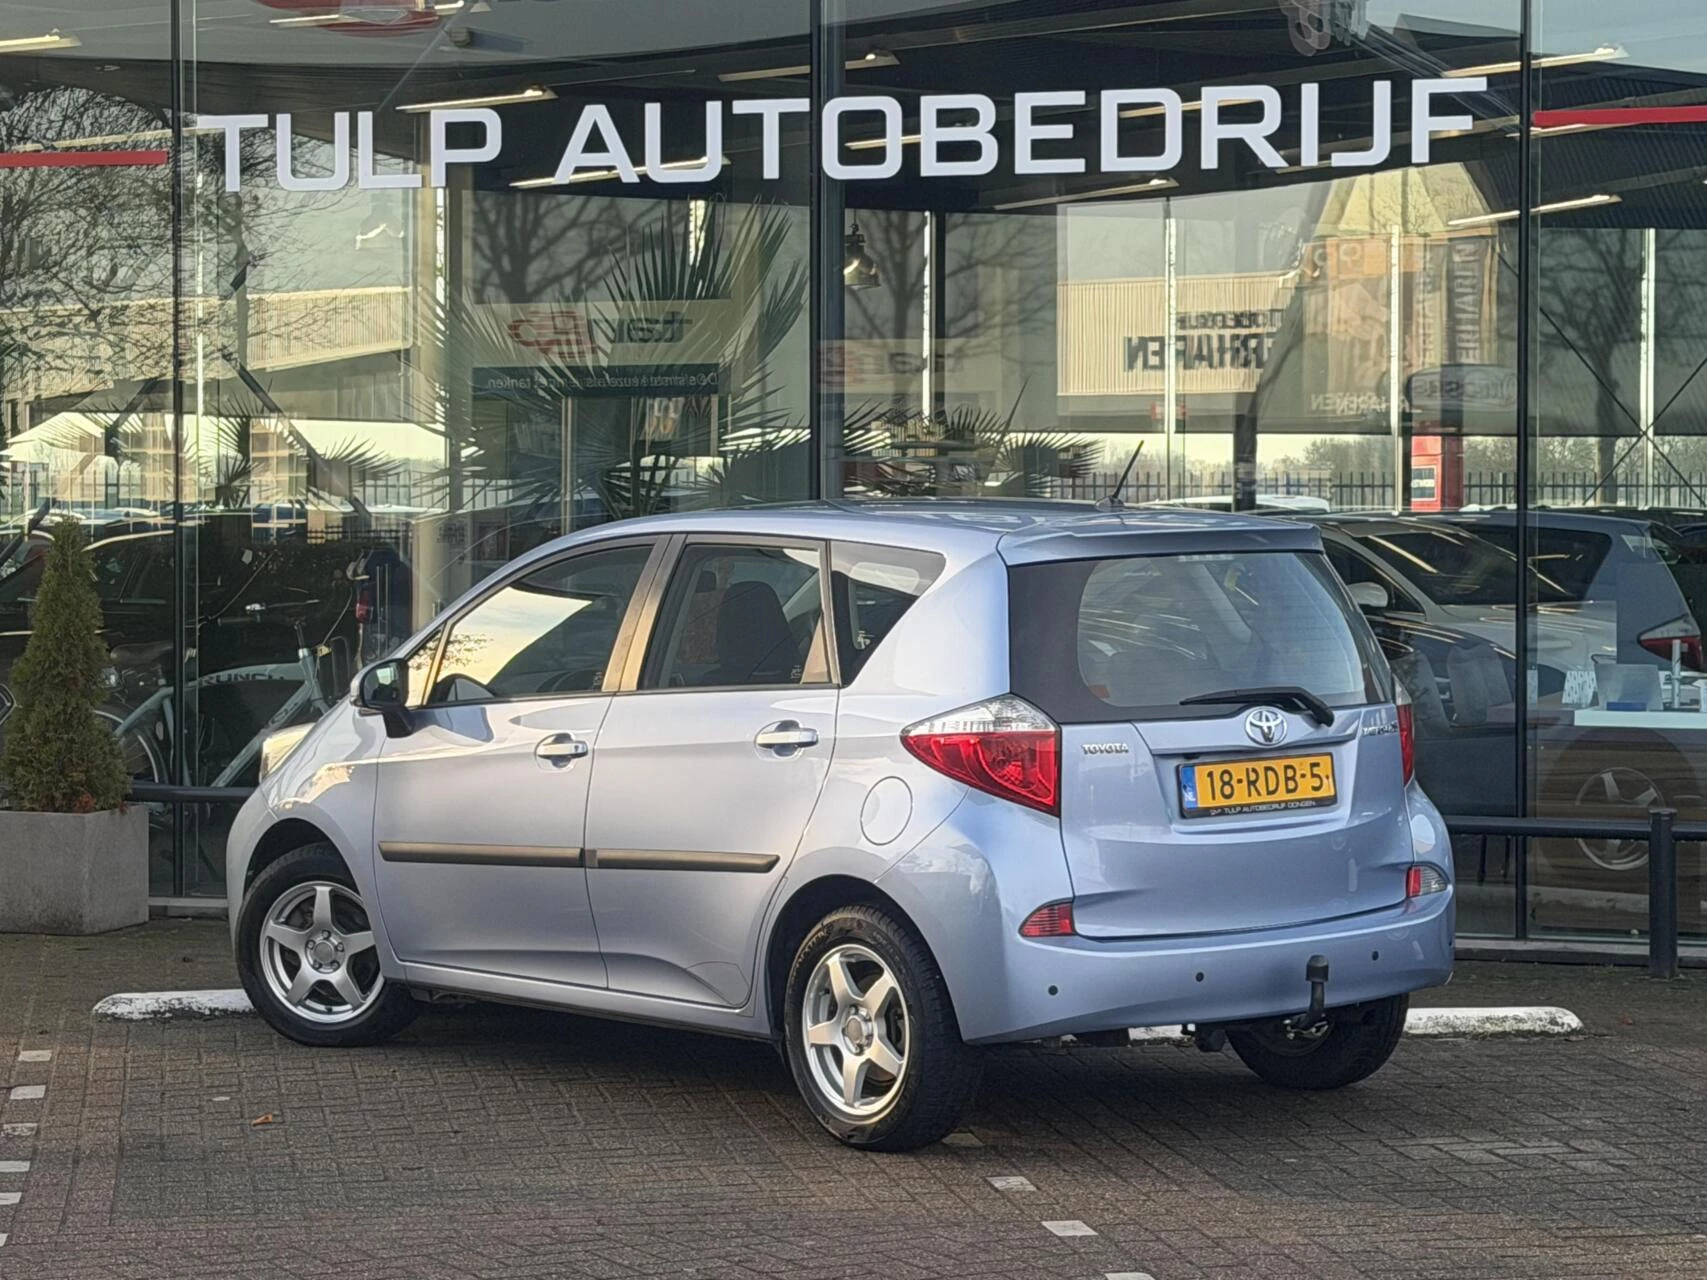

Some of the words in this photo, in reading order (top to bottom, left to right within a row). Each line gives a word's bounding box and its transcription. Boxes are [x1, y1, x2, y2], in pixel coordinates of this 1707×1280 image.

[195, 108, 502, 192] TULP
[554, 77, 1487, 184] AUTOBEDRIJF
[1081, 743, 1129, 755] TOYOTA
[1206, 762, 1324, 801] 18-RDB-5
[1224, 806, 1241, 815] TULP
